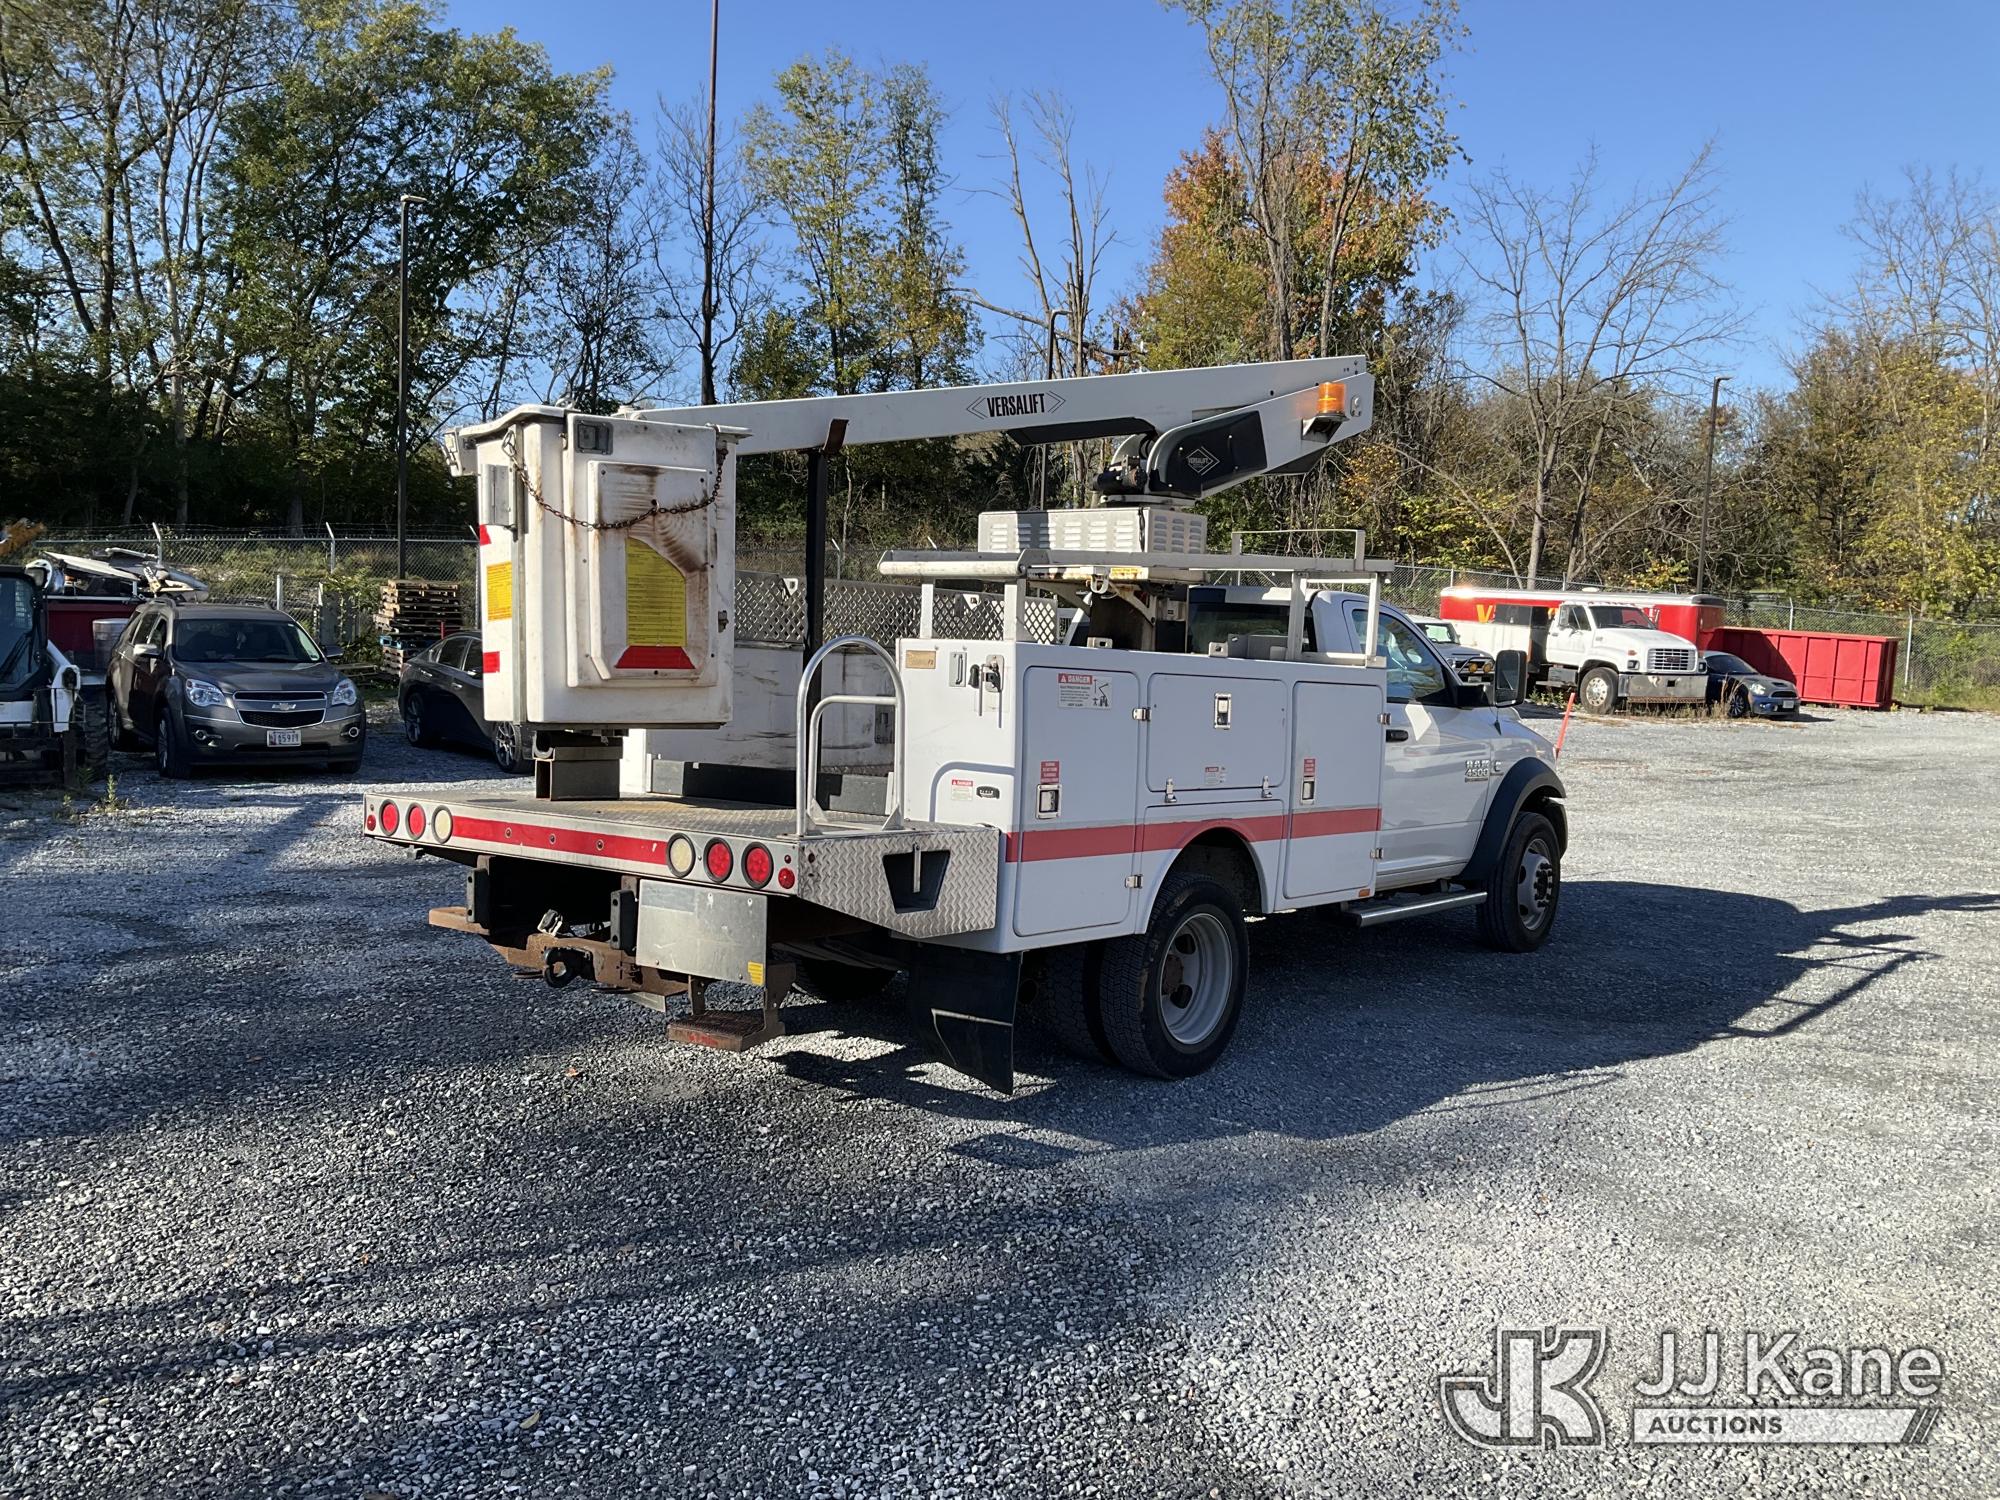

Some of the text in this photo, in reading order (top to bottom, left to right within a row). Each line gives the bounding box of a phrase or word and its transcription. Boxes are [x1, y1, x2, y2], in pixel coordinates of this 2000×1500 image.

[986, 393, 1045, 418] VERSALIFT
[1067, 675, 1091, 684] DANGER
[1466, 768, 1489, 777] 4500
